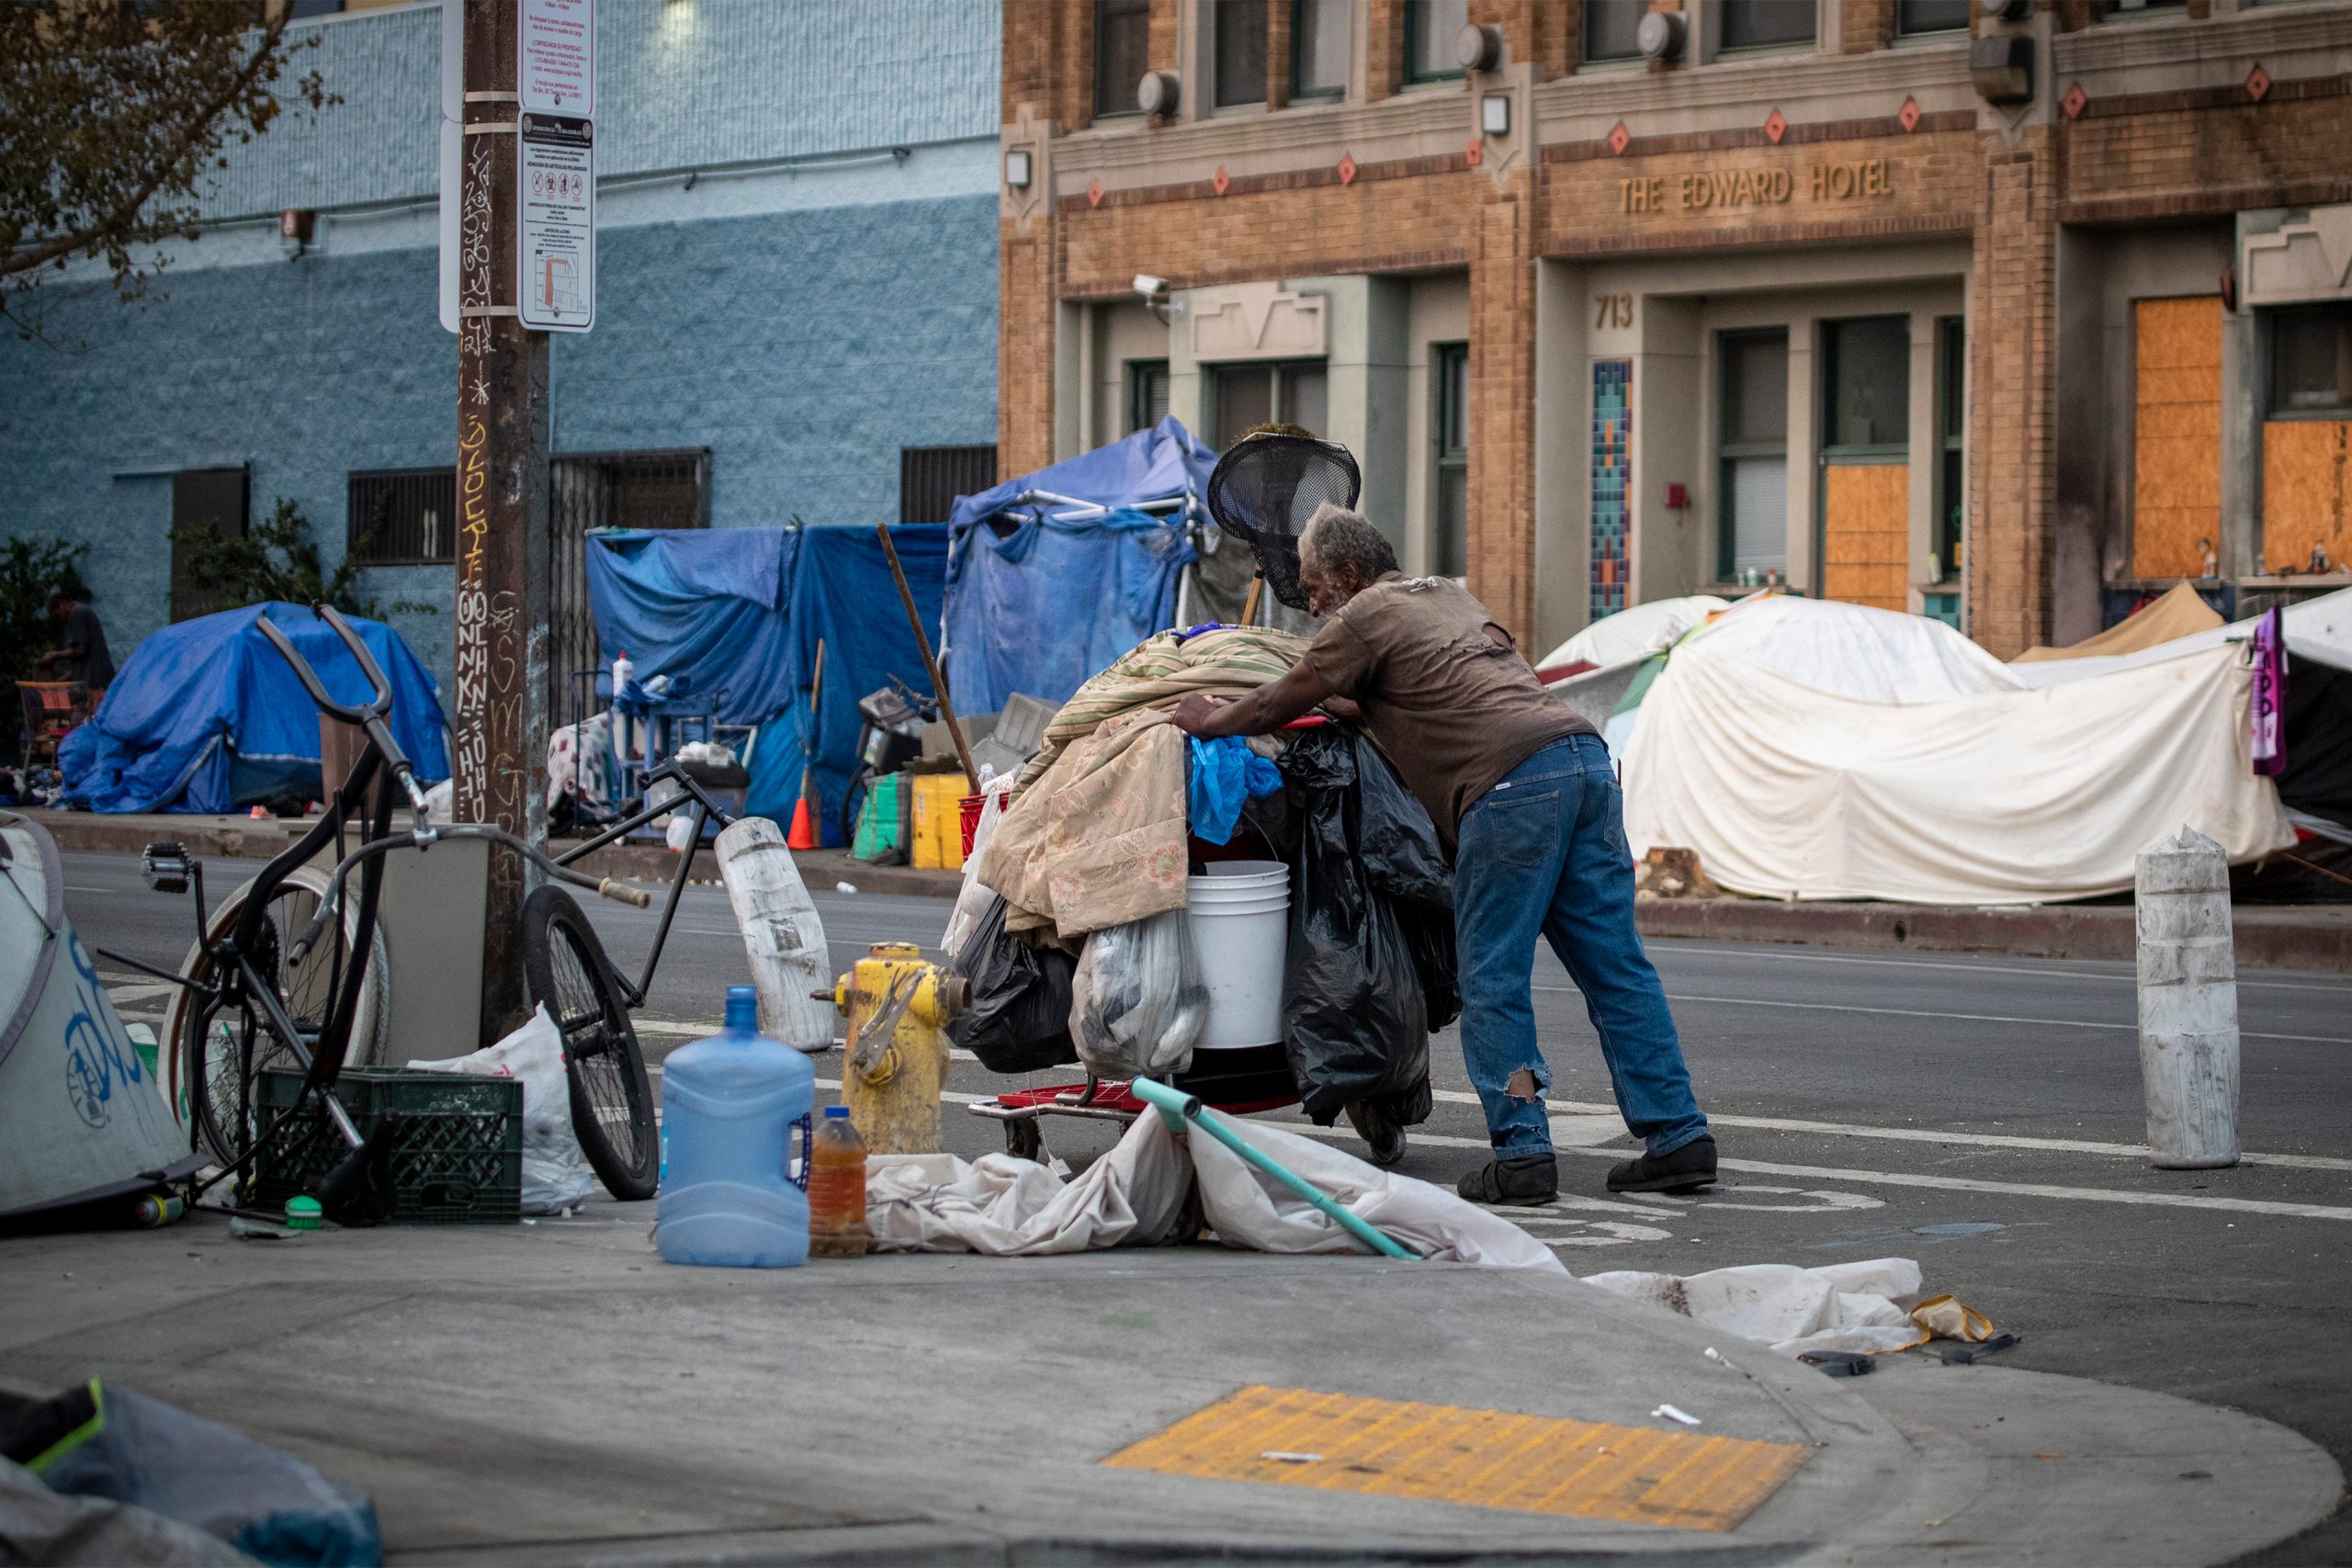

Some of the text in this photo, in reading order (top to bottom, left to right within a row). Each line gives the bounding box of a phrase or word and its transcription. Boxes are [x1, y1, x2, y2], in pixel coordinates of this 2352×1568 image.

[1620, 158, 1895, 213] THE EDWARD HOTEL
[1596, 291, 1633, 330] 713
